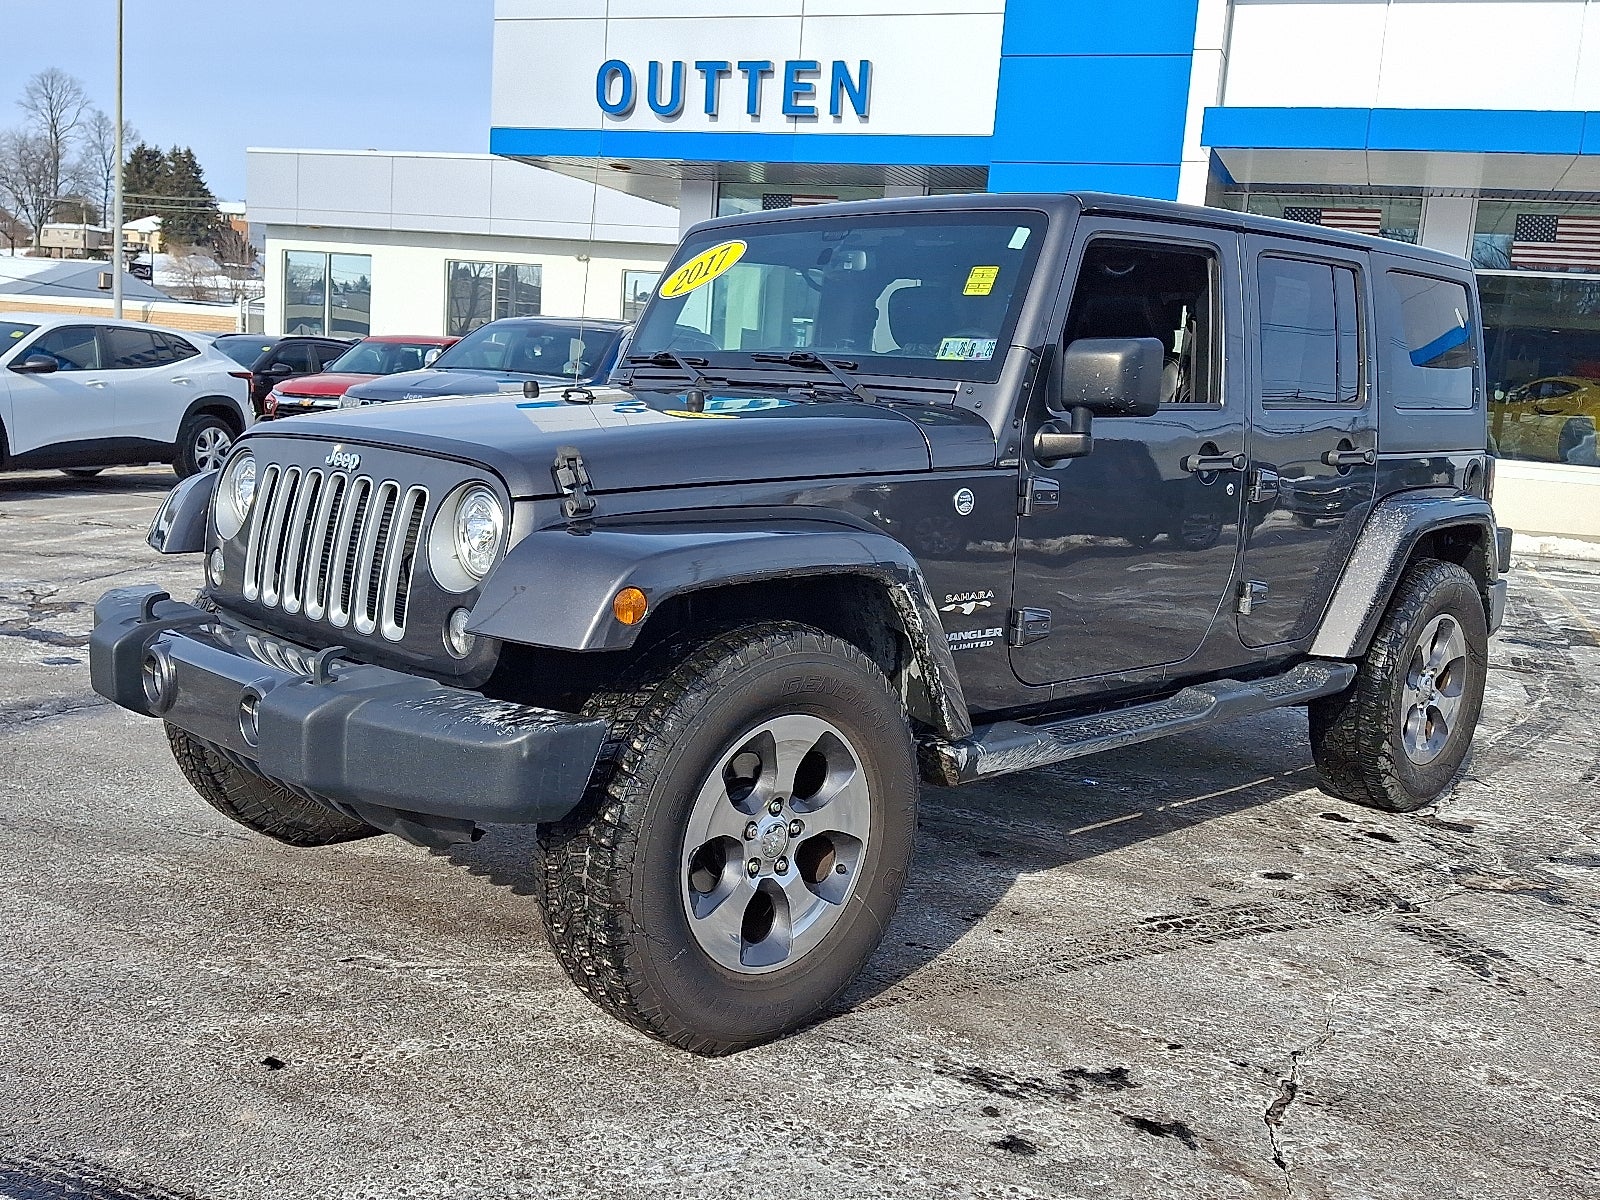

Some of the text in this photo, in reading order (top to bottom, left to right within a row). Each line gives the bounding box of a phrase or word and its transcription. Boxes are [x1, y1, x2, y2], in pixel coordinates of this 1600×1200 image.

[596, 59, 872, 117] OUTTEN
[671, 246, 731, 293] 2017
[325, 444, 361, 473] Jeep
[945, 590, 994, 603] SAHARA
[945, 627, 1003, 641] ANGLER
[950, 640, 994, 651] LIMITED
